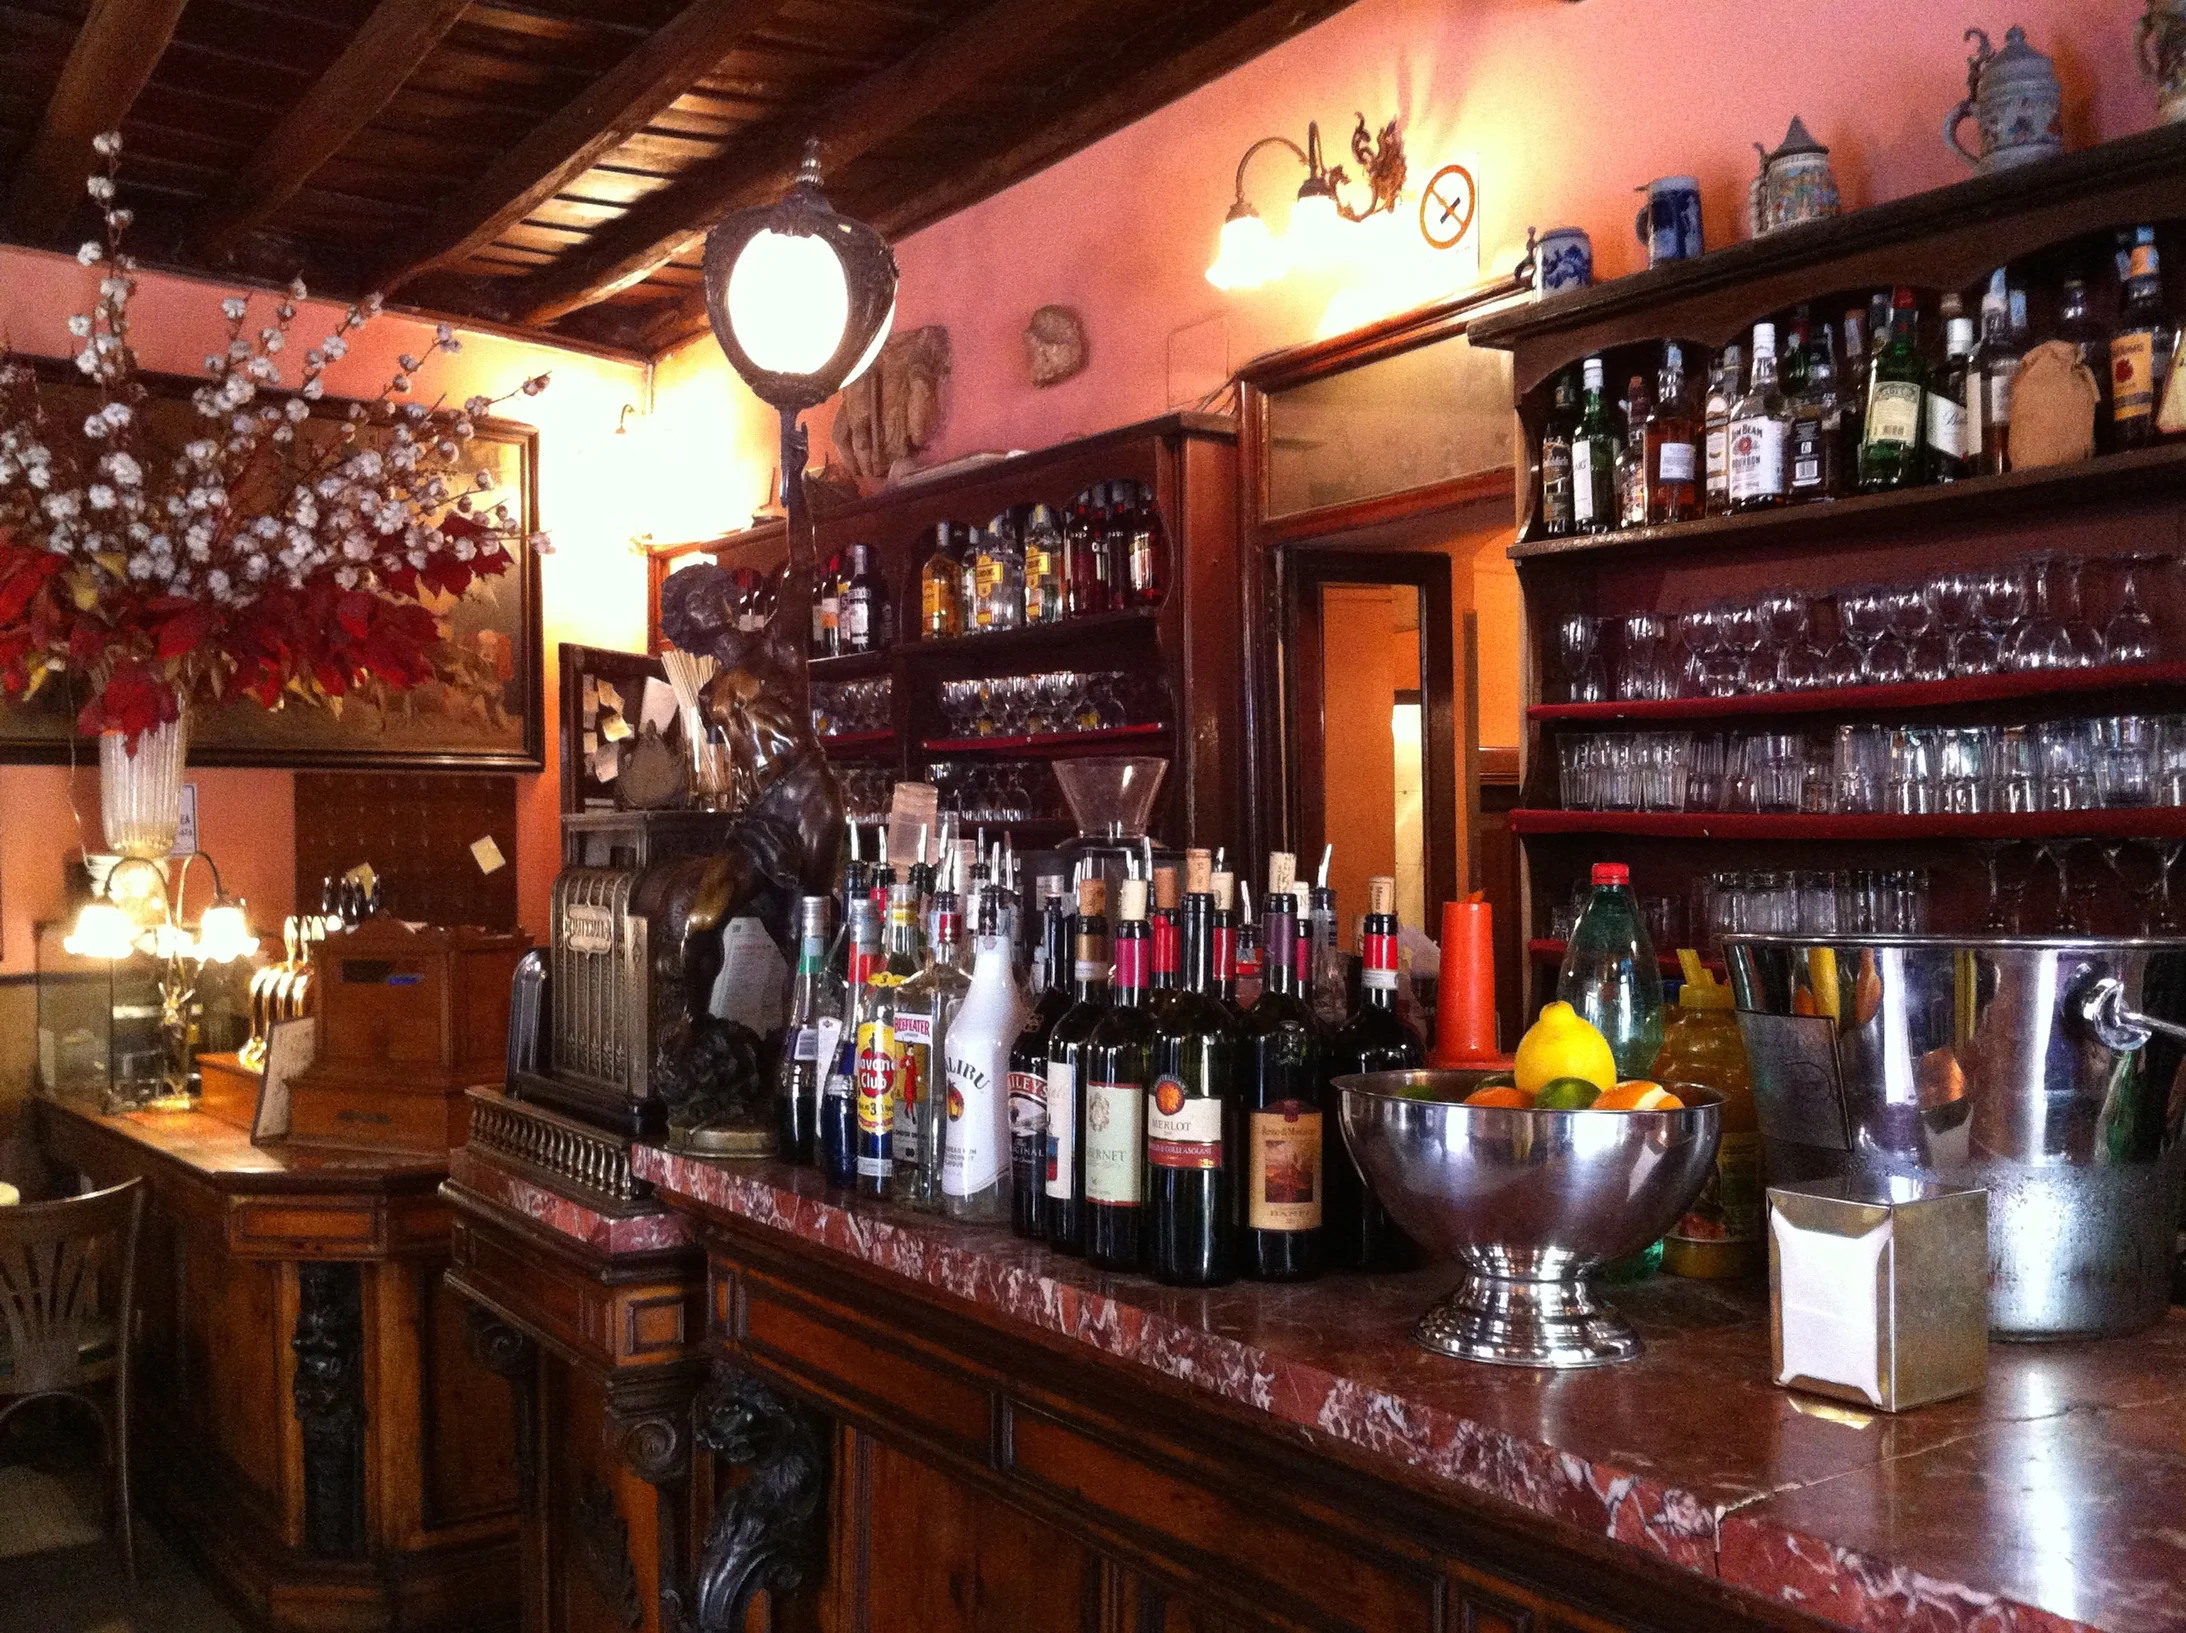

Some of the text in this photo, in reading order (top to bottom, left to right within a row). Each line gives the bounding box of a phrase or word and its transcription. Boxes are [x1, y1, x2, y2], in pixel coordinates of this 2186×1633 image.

[1742, 423, 1763, 438] BEAM
[894, 1016, 930, 1037] BEEFEATER
[861, 1057, 896, 1072] avan
[946, 1057, 990, 1090] LIBU
[861, 1071, 887, 1089] Club
[1008, 1074, 1048, 1099] AILEYS
[1151, 1118, 1191, 1132] MERLOT
